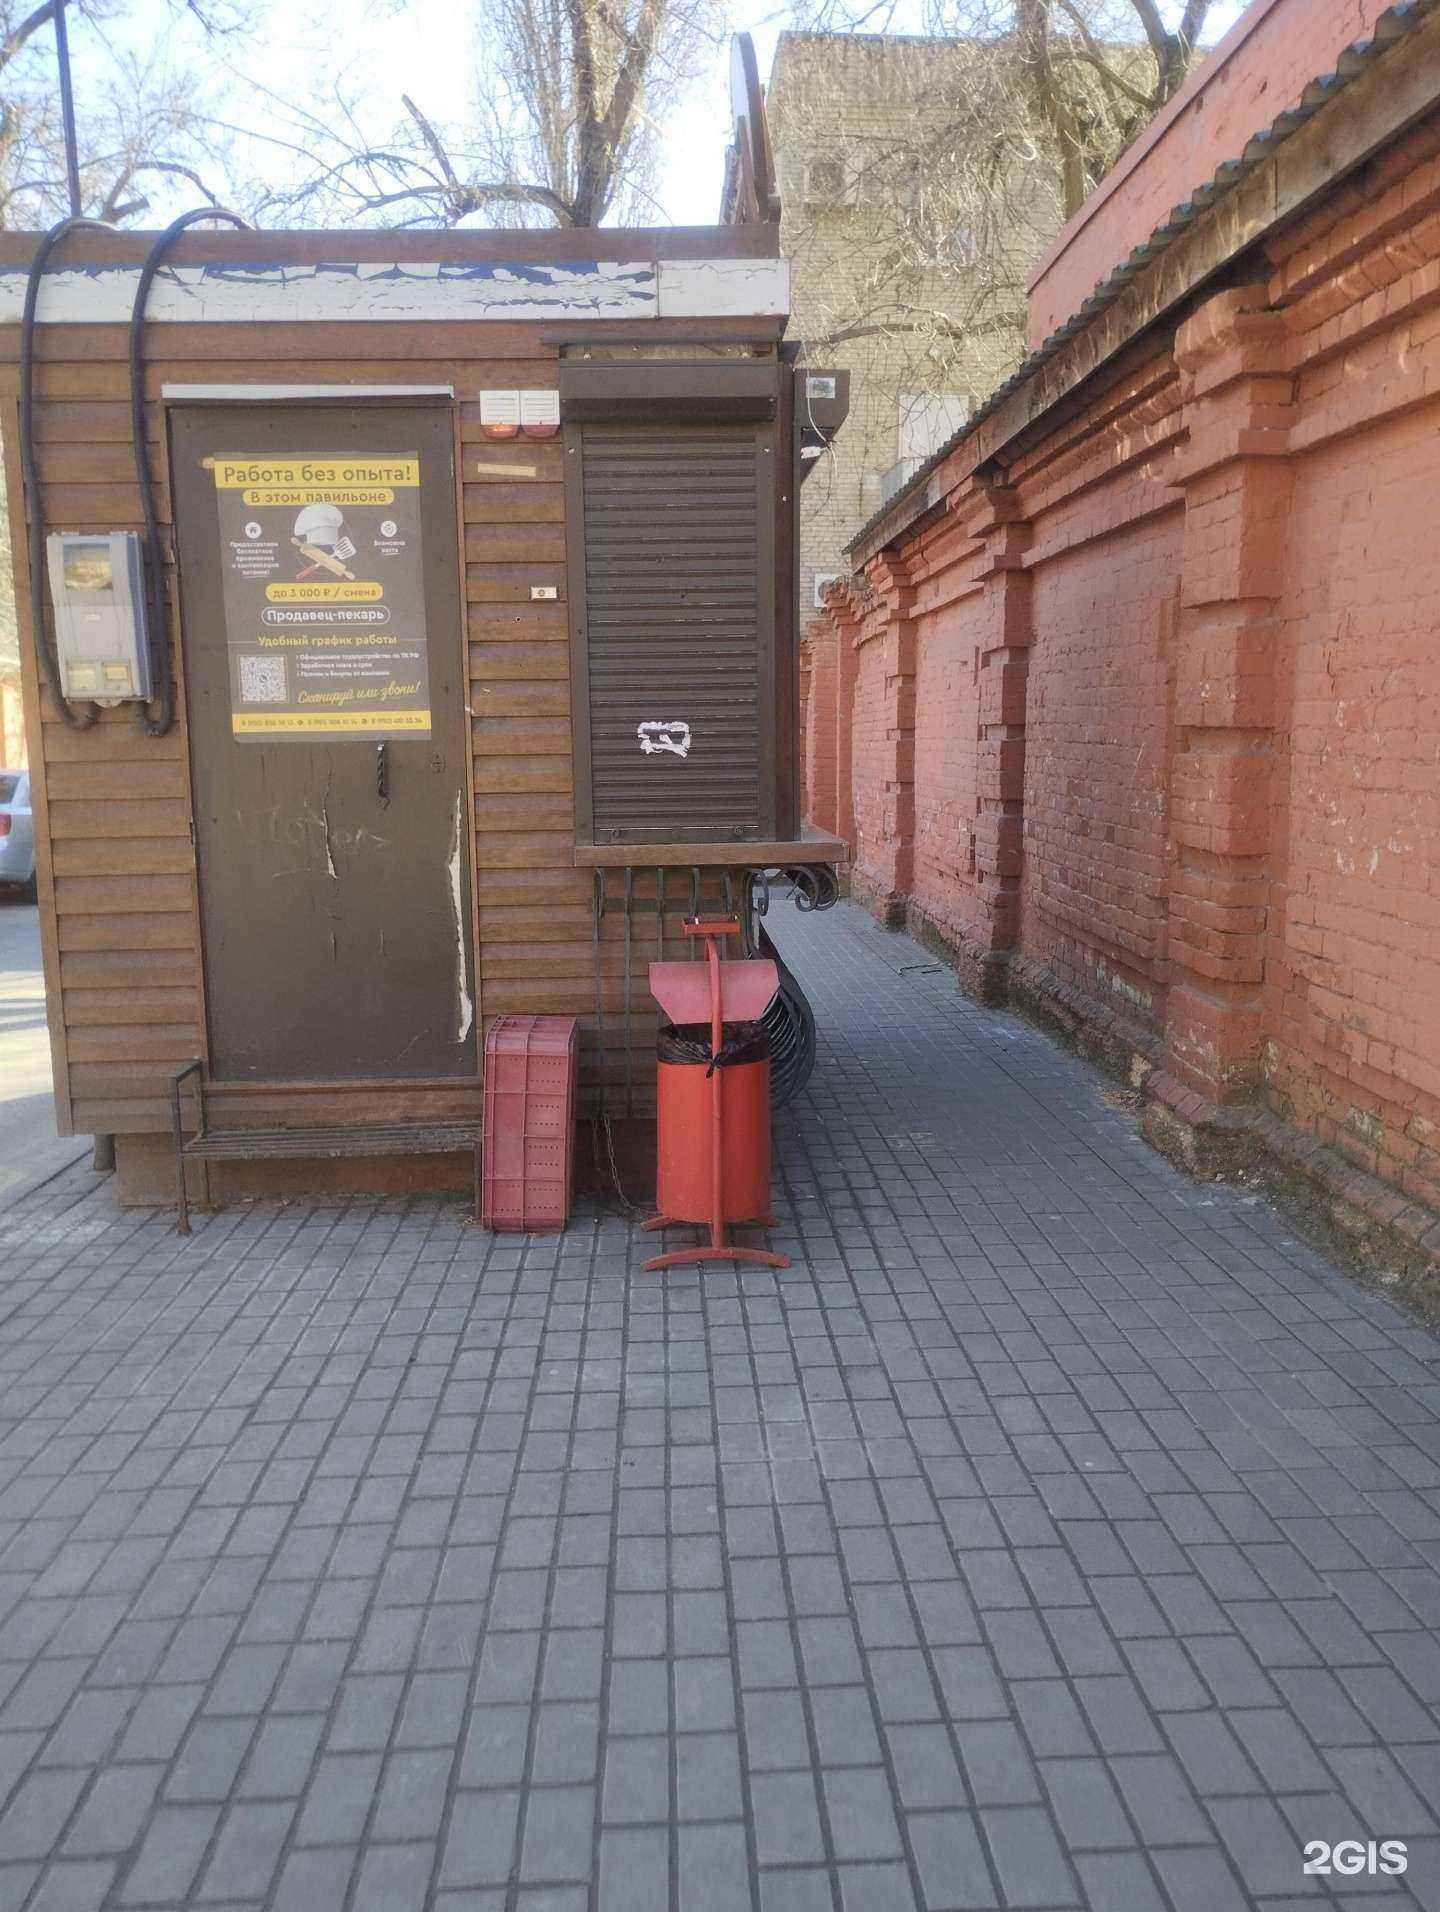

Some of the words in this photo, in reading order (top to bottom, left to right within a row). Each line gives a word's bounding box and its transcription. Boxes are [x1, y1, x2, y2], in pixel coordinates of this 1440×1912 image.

[224, 465, 294, 482] Работа
[301, 464, 336, 482] без
[343, 465, 411, 482] опыта!
[251, 491, 260, 503] В
[265, 492, 300, 503] этом
[306, 491, 386, 503] павильоне
[273, 589, 287, 599] до
[290, 589, 296, 598] 3
[299, 588, 320, 598] 000
[344, 588, 377, 597] смена
[267, 609, 385, 622] Продавец-пекарь
[258, 634, 309, 647] Удобный
[312, 634, 352, 647] график
[356, 634, 396, 646] работы
[297, 688, 354, 706] Сканируй
[356, 687, 379, 699] или
[382, 680, 422, 701] звони!
